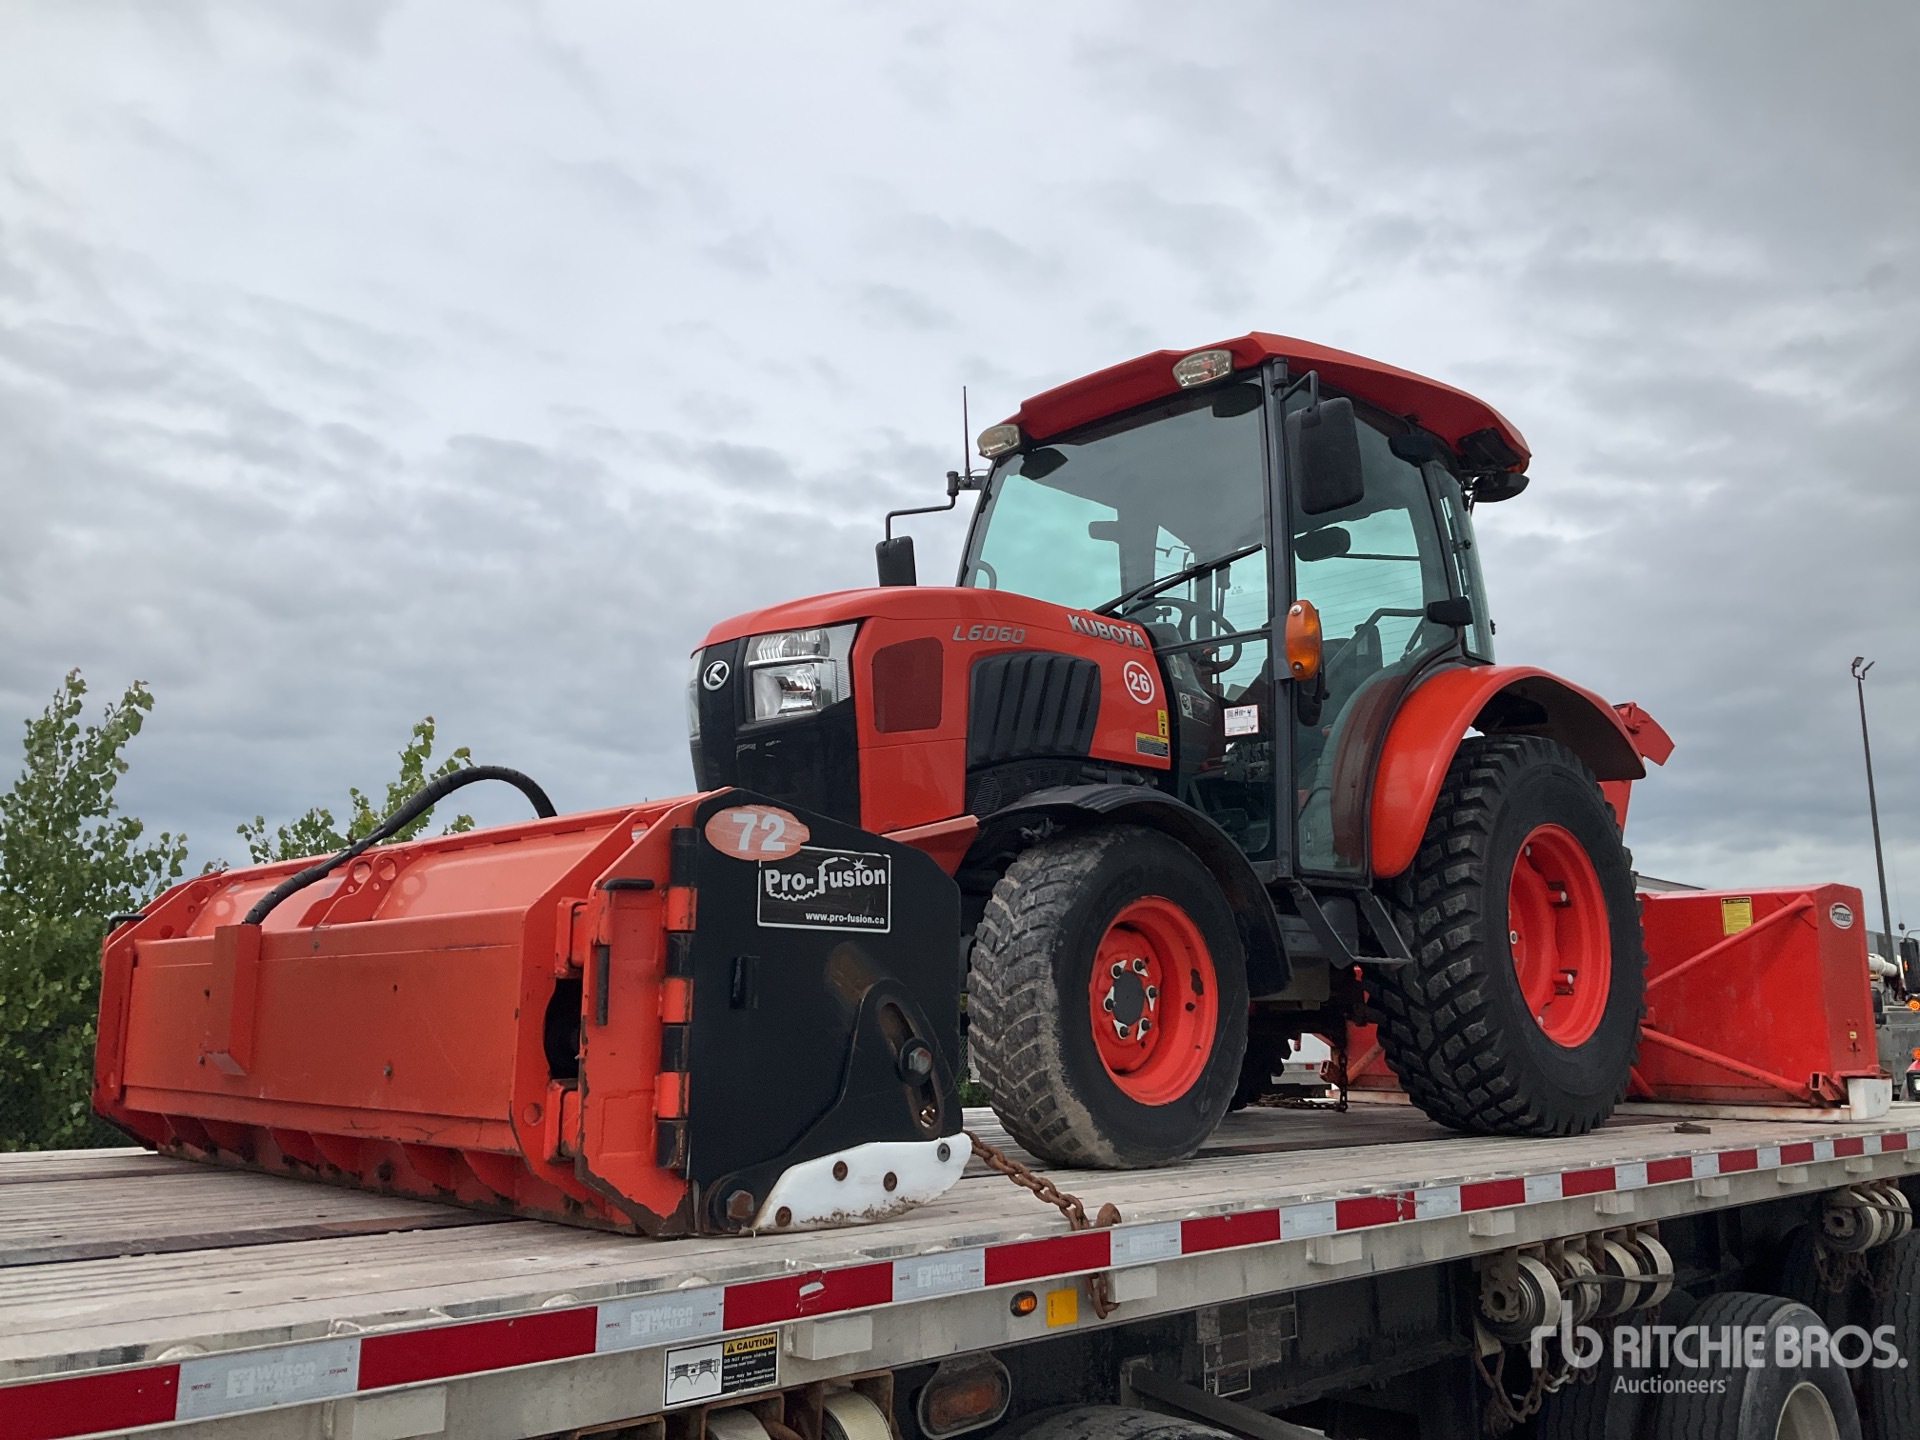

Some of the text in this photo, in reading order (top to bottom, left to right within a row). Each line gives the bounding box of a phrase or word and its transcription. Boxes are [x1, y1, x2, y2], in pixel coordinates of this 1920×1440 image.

[952, 624, 1026, 644] L6060
[1067, 613, 1147, 649] KUBOTA
[1128, 671, 1151, 694] 26
[732, 813, 786, 852] 72
[805, 912, 886, 926] www.pro-fusion.ca
[650, 1306, 694, 1322] Wilson
[736, 1336, 775, 1351] CAUTION
